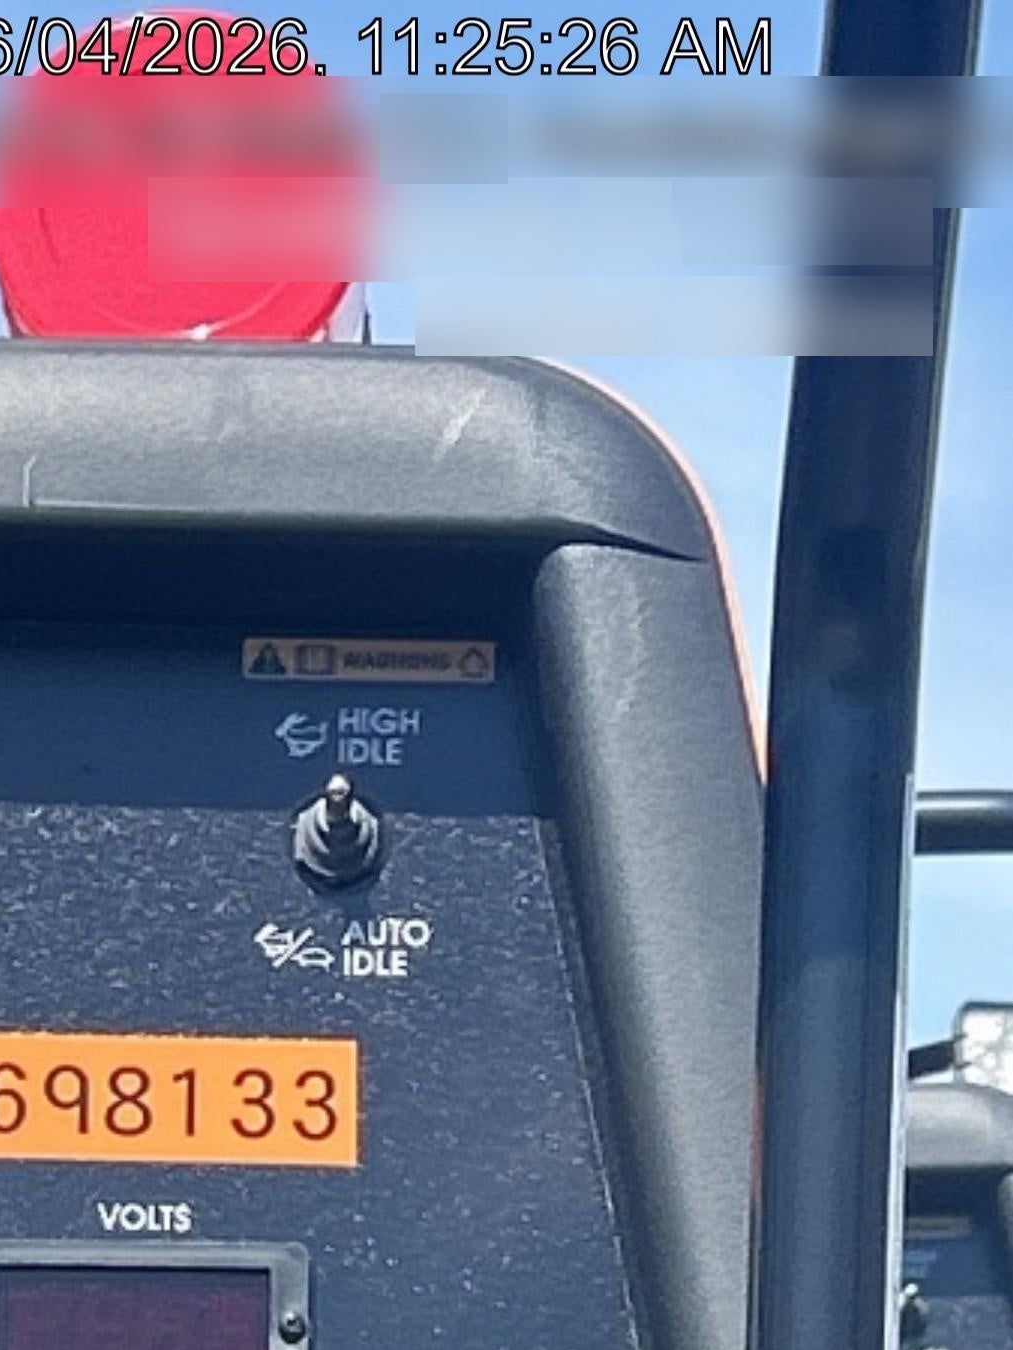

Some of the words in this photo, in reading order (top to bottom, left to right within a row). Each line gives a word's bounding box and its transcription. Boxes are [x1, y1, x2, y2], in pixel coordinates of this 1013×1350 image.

[338, 708, 420, 735] HIGH
[339, 738, 403, 765] IDLE
[341, 918, 431, 947] AUTO
[343, 949, 408, 977] IDLE
[97, 1202, 192, 1233] VOLTS
